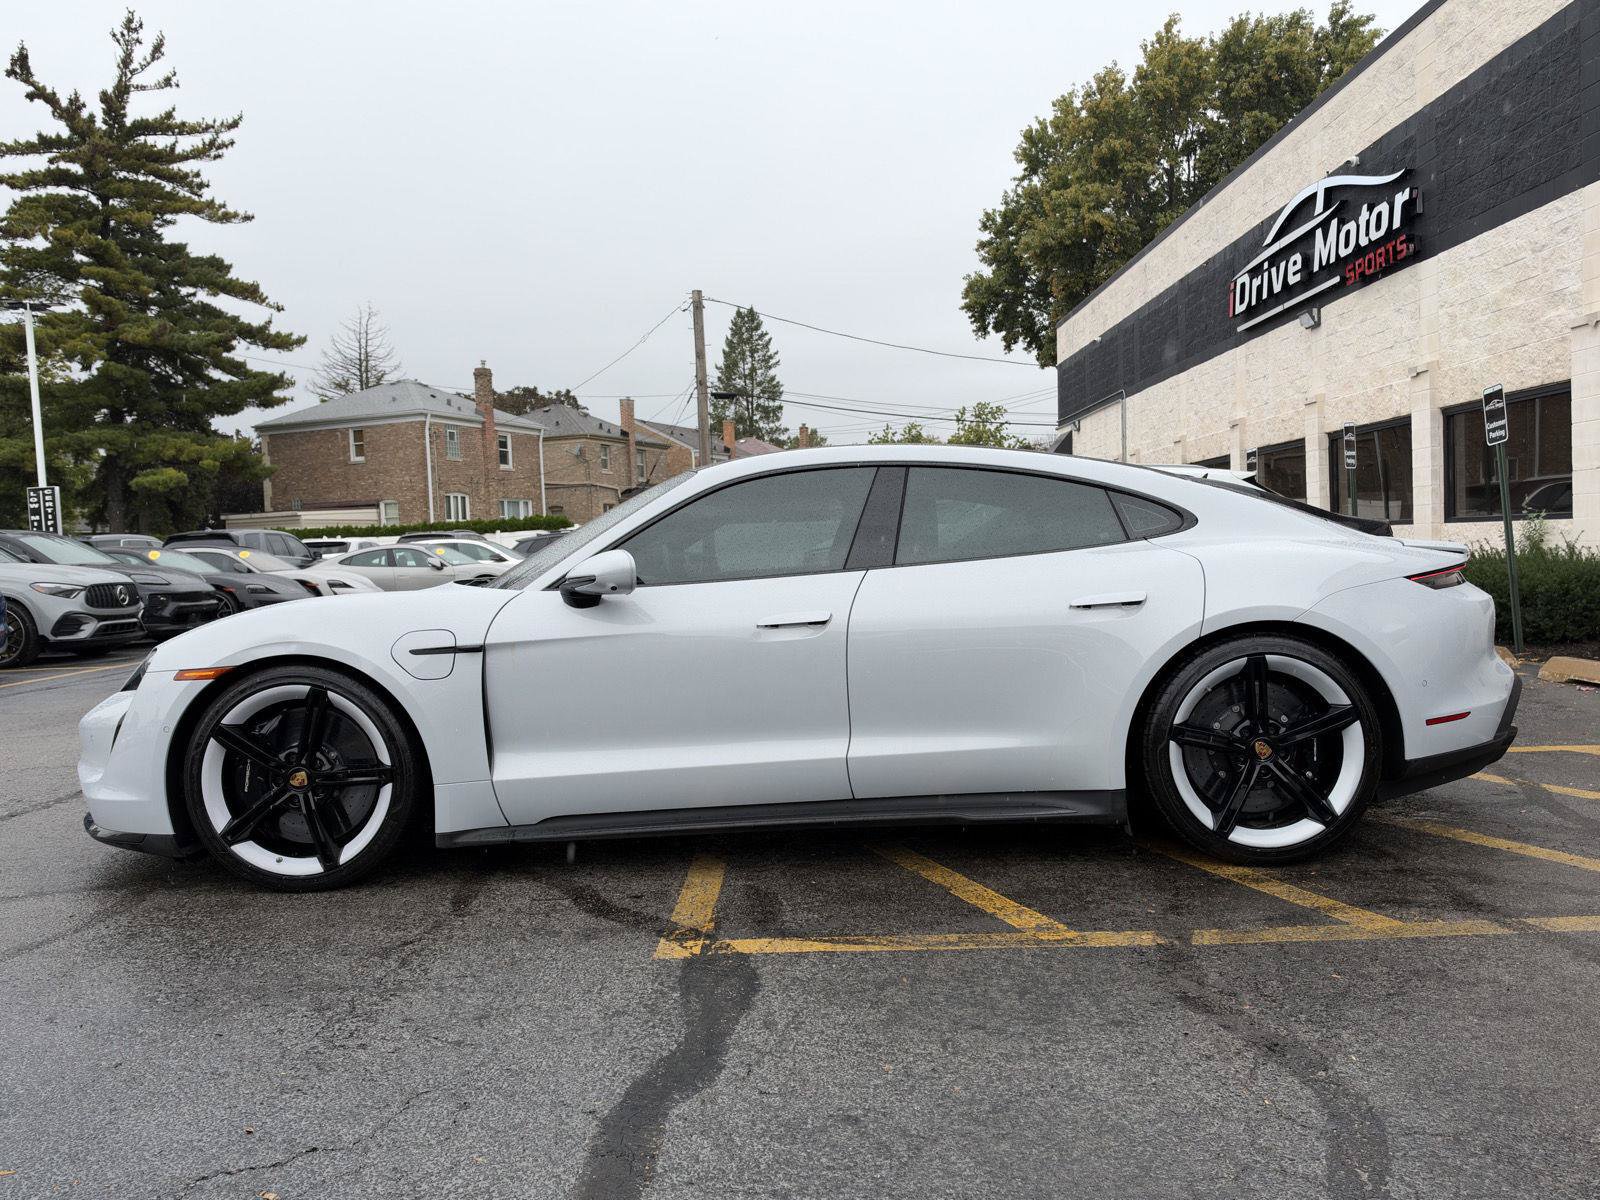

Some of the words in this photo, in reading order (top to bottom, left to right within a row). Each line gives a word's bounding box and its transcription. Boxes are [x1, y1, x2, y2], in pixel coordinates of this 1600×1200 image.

[1229, 252, 1302, 318] iDrive
[1313, 186, 1410, 272] Motor
[1345, 234, 1407, 286] SPORTS
[29, 491, 39, 509] LOW
